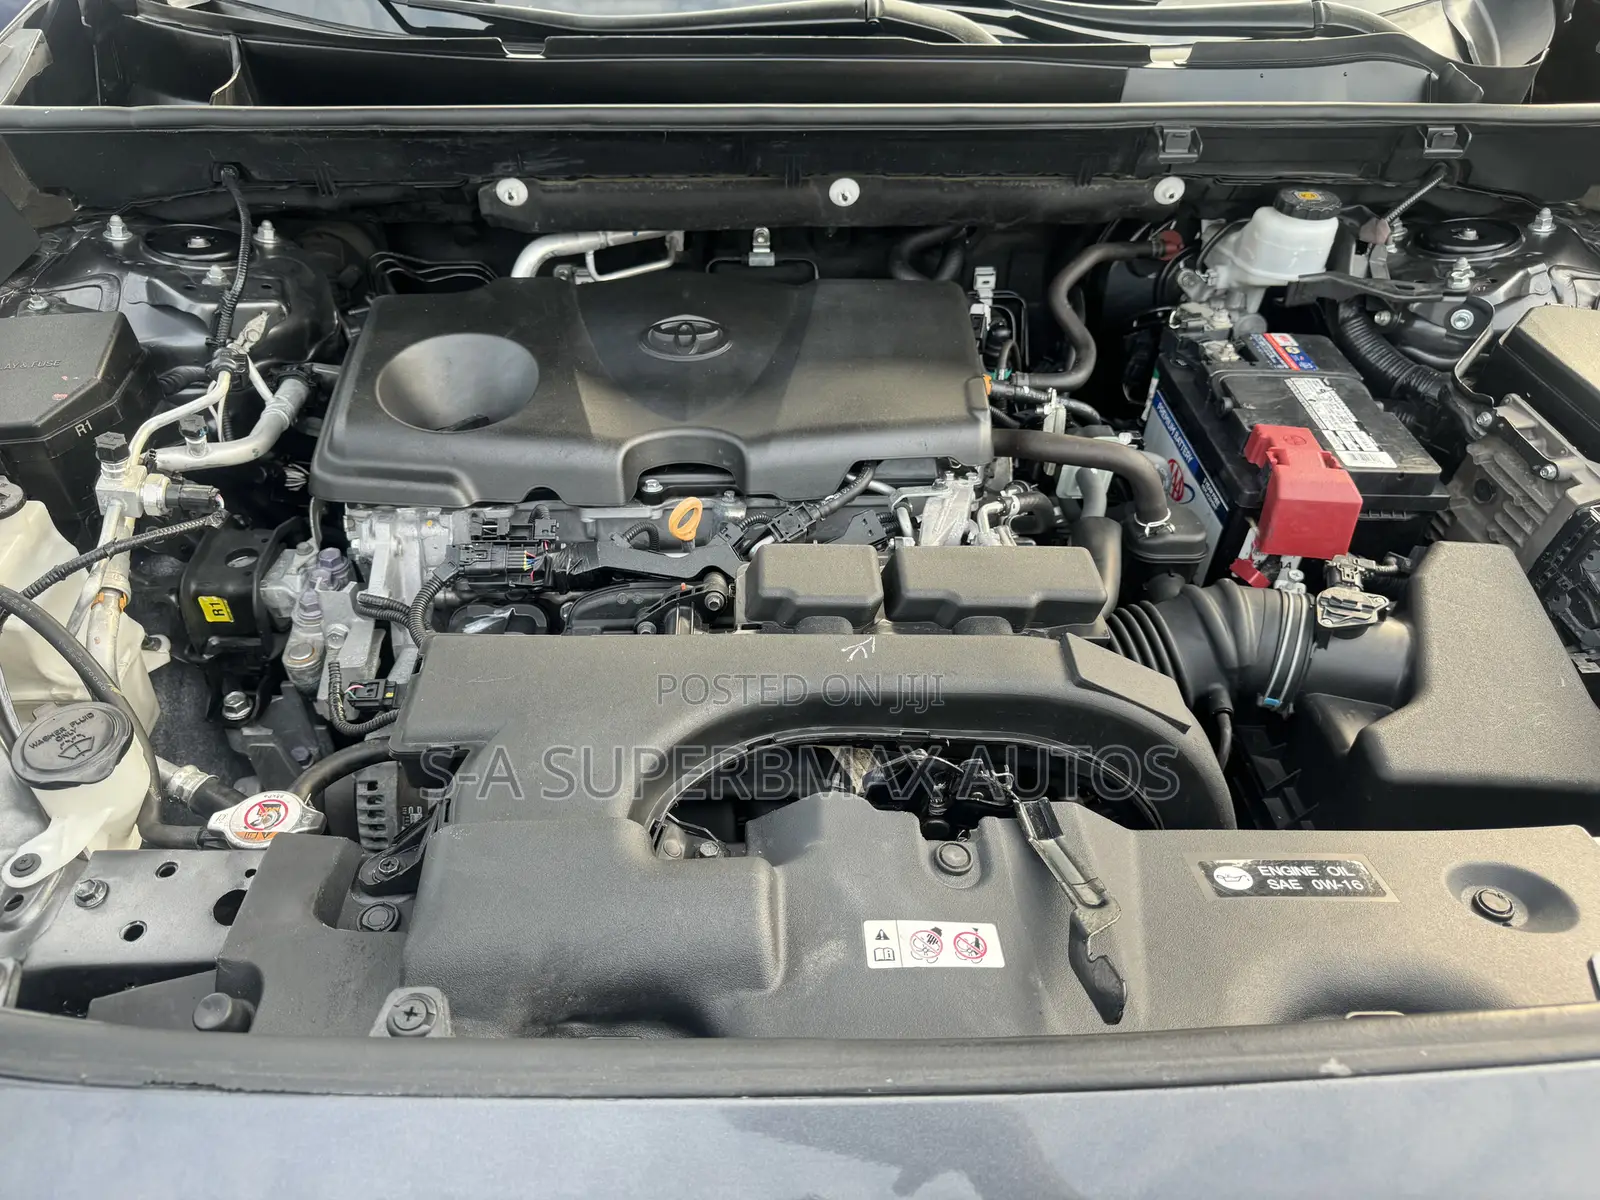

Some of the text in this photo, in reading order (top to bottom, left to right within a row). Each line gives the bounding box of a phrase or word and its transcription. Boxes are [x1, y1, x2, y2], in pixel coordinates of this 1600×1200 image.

[31, 359, 61, 369] FUSE
[74, 420, 93, 437] R1
[1173, 430, 1194, 464] BATTERY
[209, 602, 225, 616] R1
[29, 712, 95, 749] WASHER FLUID
[55, 727, 78, 742] ONLY
[1257, 865, 1357, 877] ENGINE OIL
[1266, 878, 1364, 890] SAE 0W-16
